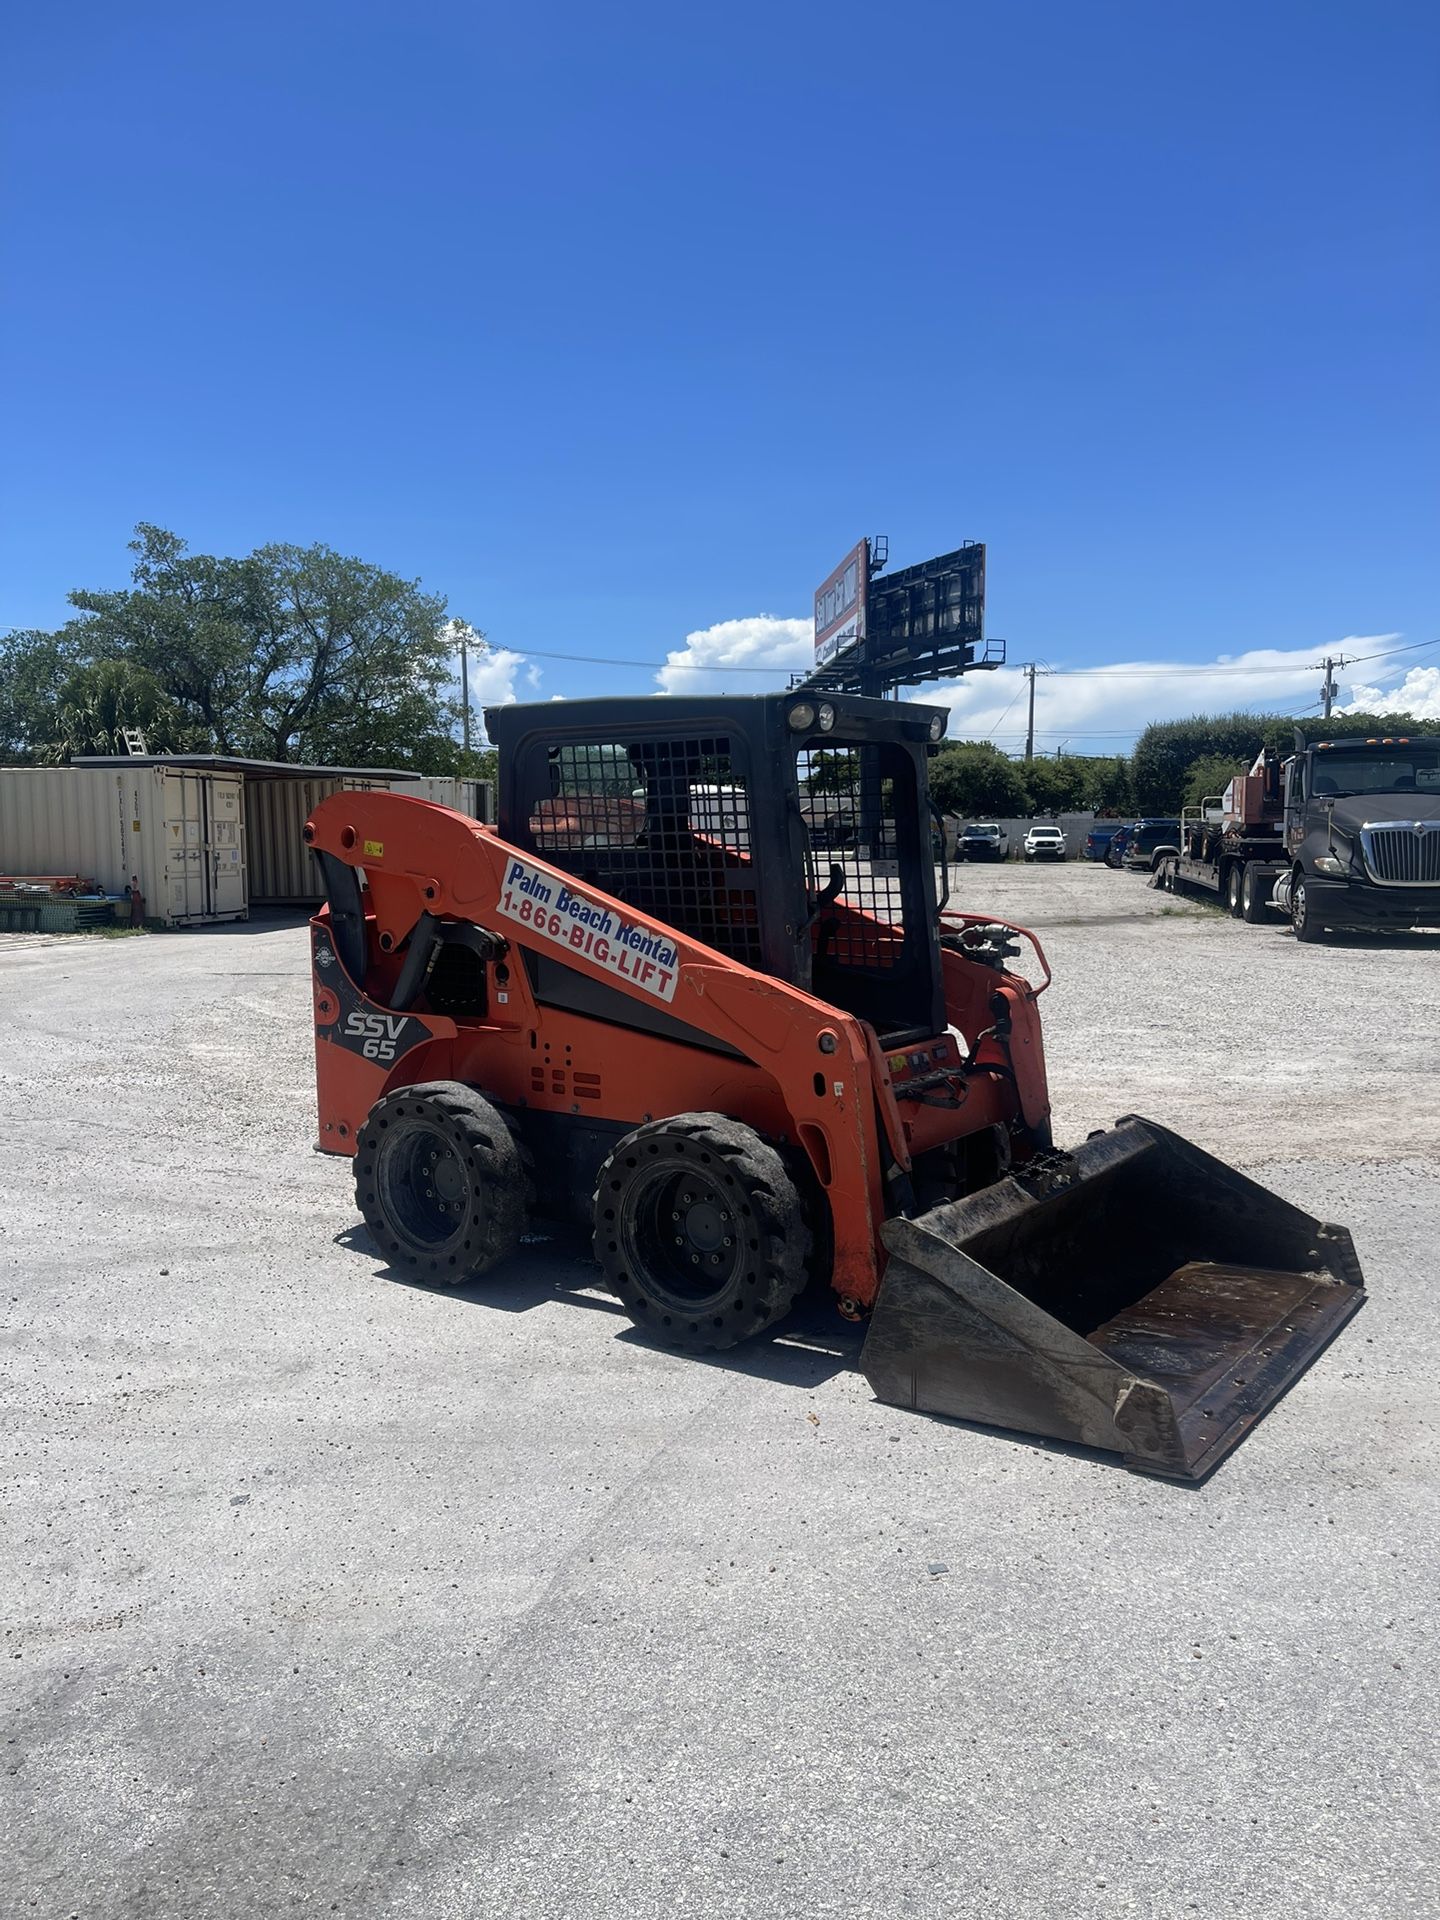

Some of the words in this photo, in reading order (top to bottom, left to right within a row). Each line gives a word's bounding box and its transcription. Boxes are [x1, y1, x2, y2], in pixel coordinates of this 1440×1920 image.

[503, 890, 673, 994] 1-866-BIG-LIFT
[507, 862, 552, 904] Palm
[555, 887, 612, 935] Beach
[615, 922, 678, 969] Rental
[344, 1012, 409, 1040] SSV
[362, 1039, 397, 1060] 65
